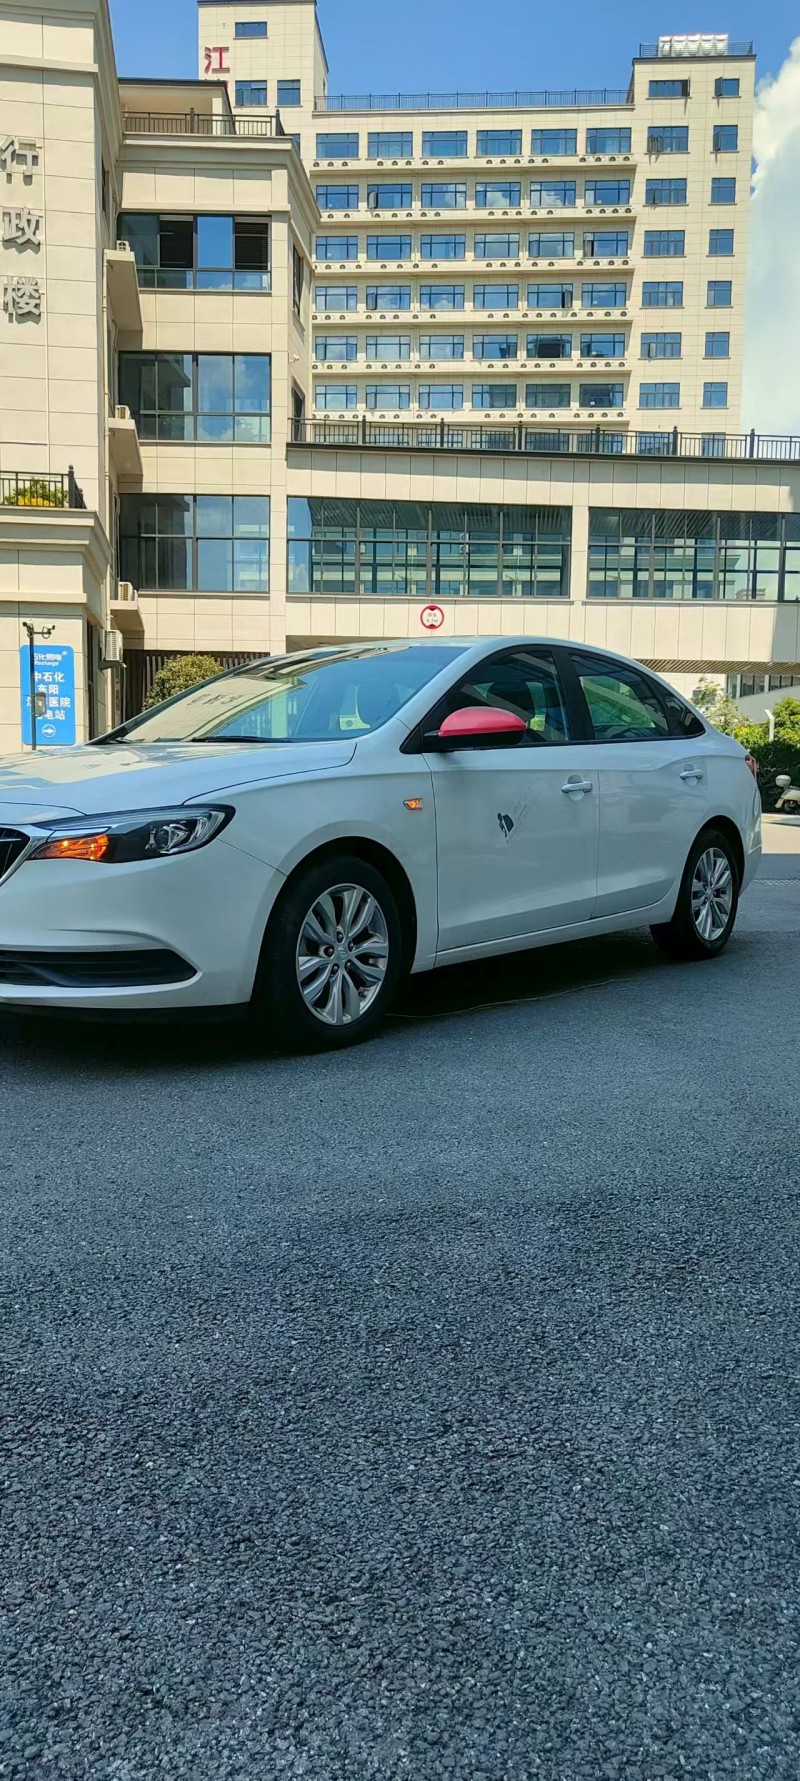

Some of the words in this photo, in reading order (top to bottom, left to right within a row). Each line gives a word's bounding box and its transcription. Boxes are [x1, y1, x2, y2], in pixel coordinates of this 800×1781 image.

[204, 46, 230, 74] 江
[0, 136, 41, 316] 行政楼
[34, 671, 65, 682] 中石化
